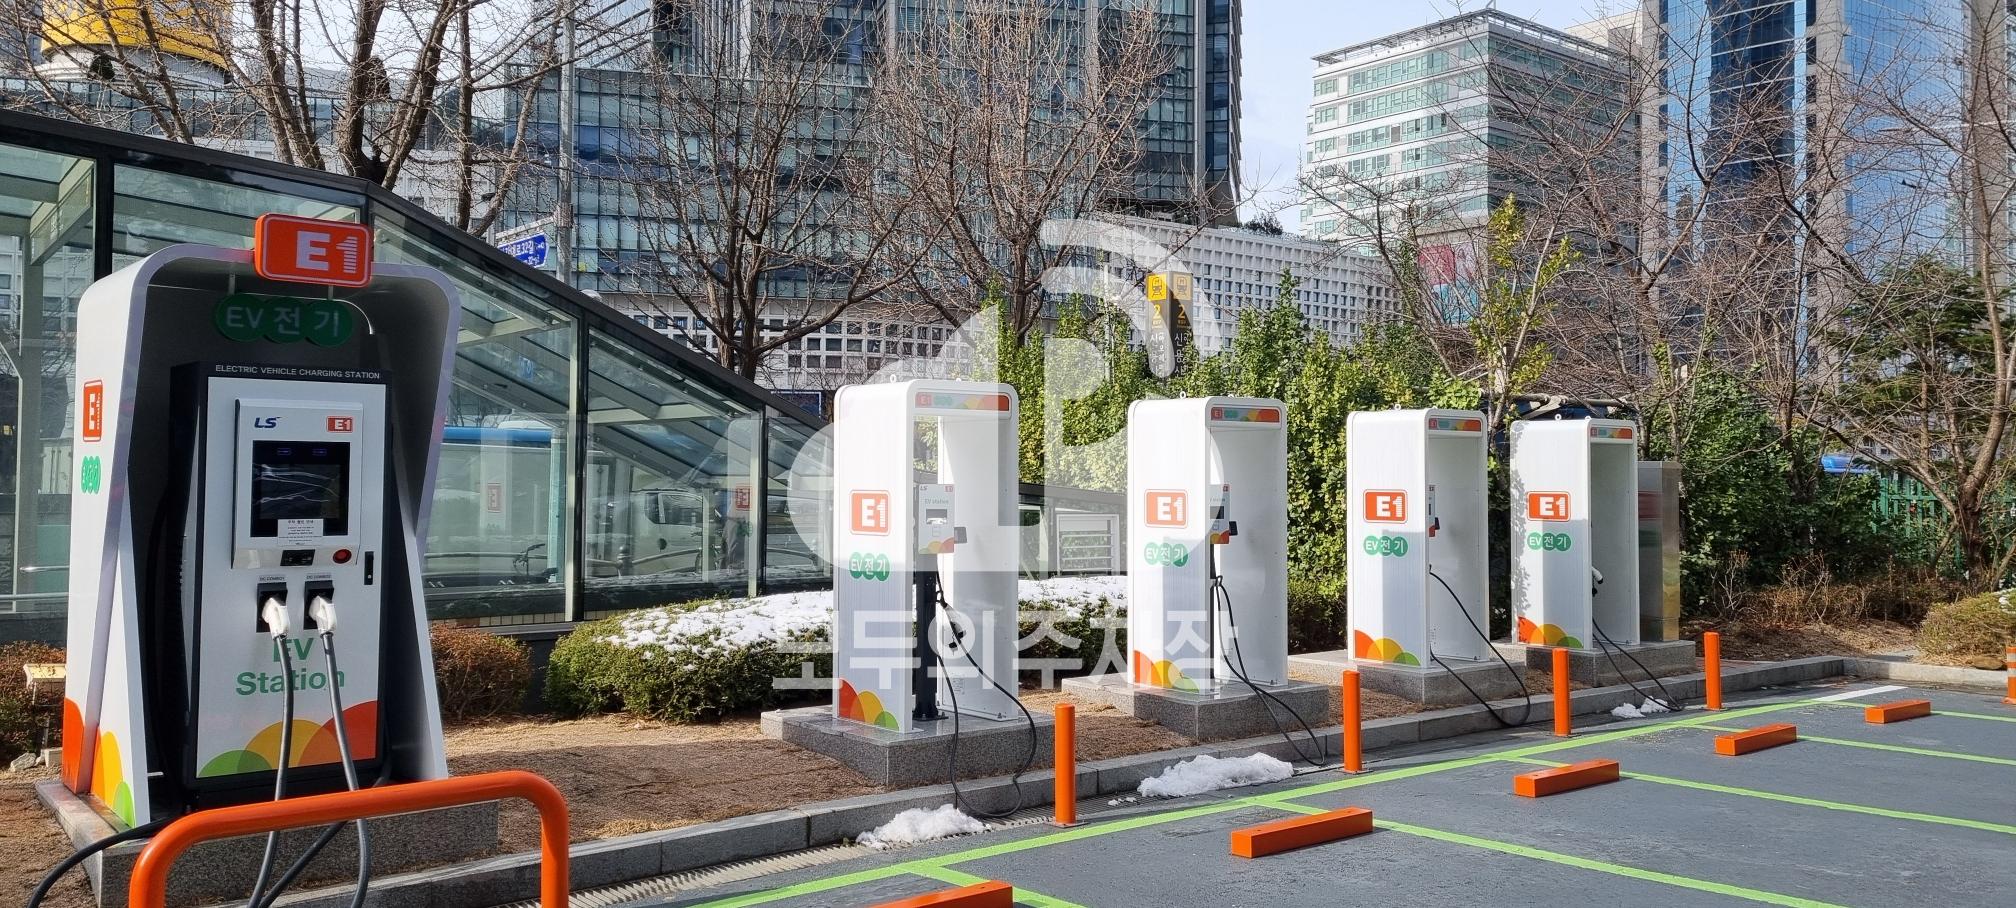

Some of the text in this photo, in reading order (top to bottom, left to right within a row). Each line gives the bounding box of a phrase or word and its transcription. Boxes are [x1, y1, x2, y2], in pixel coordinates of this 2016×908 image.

[296, 231, 358, 274] E1
[1153, 304, 1162, 319] 2
[1178, 305, 1186, 319] 2
[215, 365, 381, 379] ELECTRIC VEHICLE CHARGING STATION
[89, 393, 101, 430] E1
[254, 416, 282, 429] LS
[334, 419, 352, 430] E1
[861, 498, 887, 528] E1
[1157, 496, 1184, 522] E1
[1376, 496, 1403, 518] E1
[1540, 496, 1566, 516] E1
[273, 637, 314, 662] EV
[236, 668, 345, 696] Station
